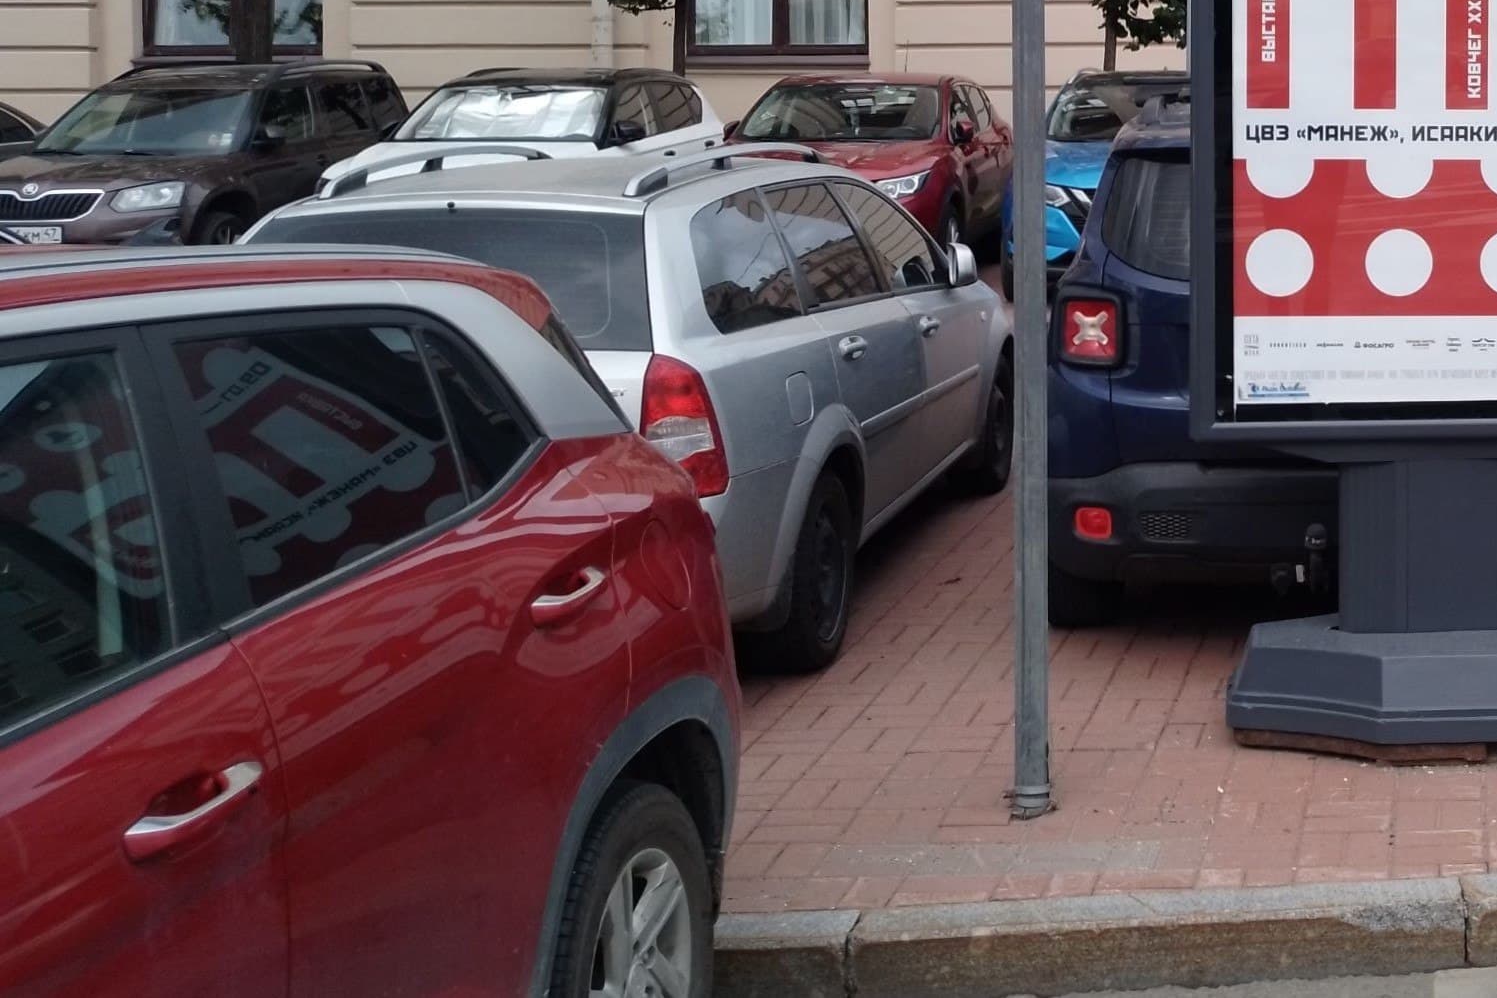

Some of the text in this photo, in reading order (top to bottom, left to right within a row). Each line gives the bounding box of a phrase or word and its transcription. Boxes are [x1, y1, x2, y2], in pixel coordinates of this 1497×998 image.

[1467, 27, 1482, 99] КОВЧЕГ
[1246, 124, 1290, 144] ЦВЗ
[1296, 124, 1404, 144] «МАНЕЖ»,
